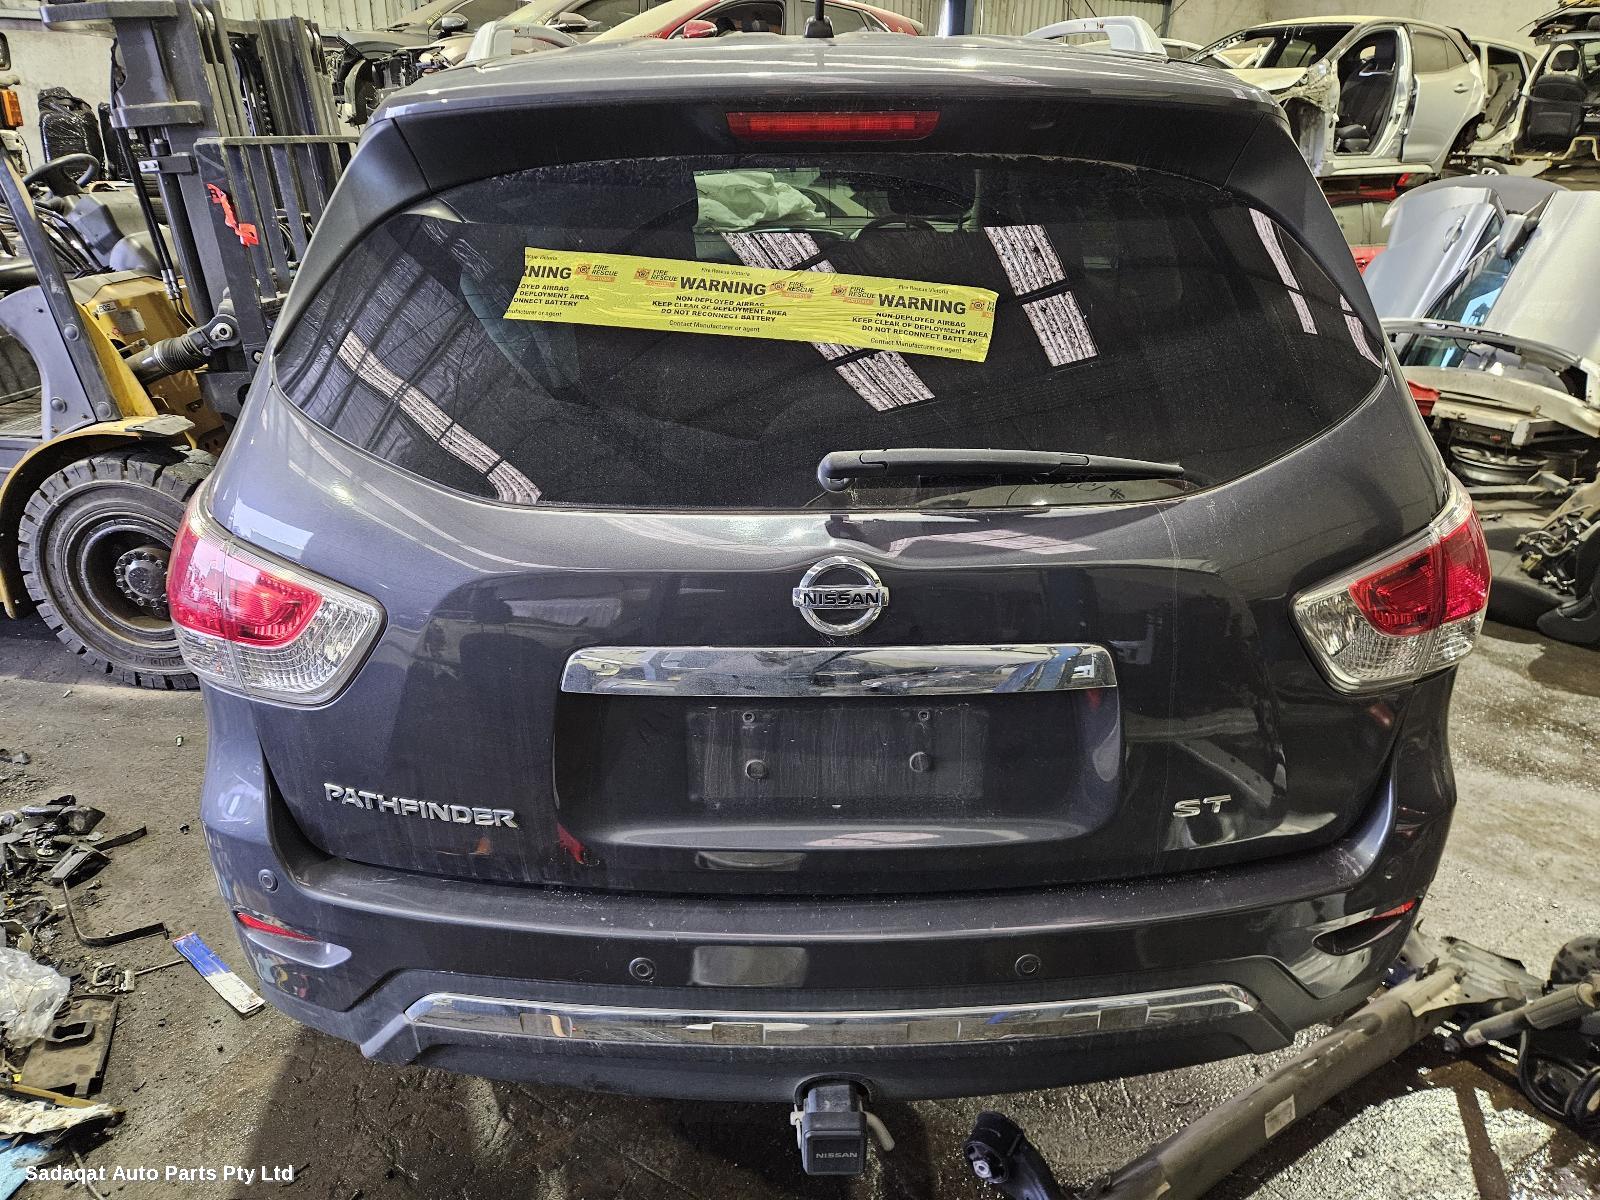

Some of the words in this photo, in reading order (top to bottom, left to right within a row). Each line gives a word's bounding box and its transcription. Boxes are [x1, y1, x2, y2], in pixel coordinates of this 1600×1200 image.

[650, 274, 679, 282] RESCUE
[541, 284, 570, 292] AIRBAG
[680, 276, 767, 296] WARNING
[786, 286, 815, 294] RESCUE
[519, 290, 568, 299] DEPLOYMENT
[569, 293, 590, 301] AREA
[848, 291, 876, 299] RESCUE
[544, 299, 579, 307] BATTERY
[651, 300, 673, 308] KEEP
[712, 305, 766, 315] DEPLOYMENT
[766, 309, 788, 317] AREA
[735, 300, 765, 308] AIRBAG
[878, 293, 967, 315] WARNING
[691, 311, 739, 320] RECONNECT
[740, 314, 777, 323] BATTERY
[937, 319, 966, 328] AIRBAG
[669, 320, 693, 328] Contact
[693, 322, 734, 331] Manufacturer
[742, 326, 760, 334] agent
[851, 316, 873, 324] KEEP
[874, 319, 900, 327] CLEAR
[914, 323, 966, 336] DEPLOYMENT
[967, 330, 989, 339] AREA
[874, 326, 892, 334] NOT
[893, 329, 941, 340] RECONNECT
[942, 334, 979, 345] BATTERY
[870, 337, 894, 346] Contact
[895, 339, 935, 351] Manufacturer
[944, 346, 962, 354] agent
[803, 592, 879, 605] NISSAN
[323, 783, 519, 829] PATHFINDER
[1173, 794, 1232, 818] ST
